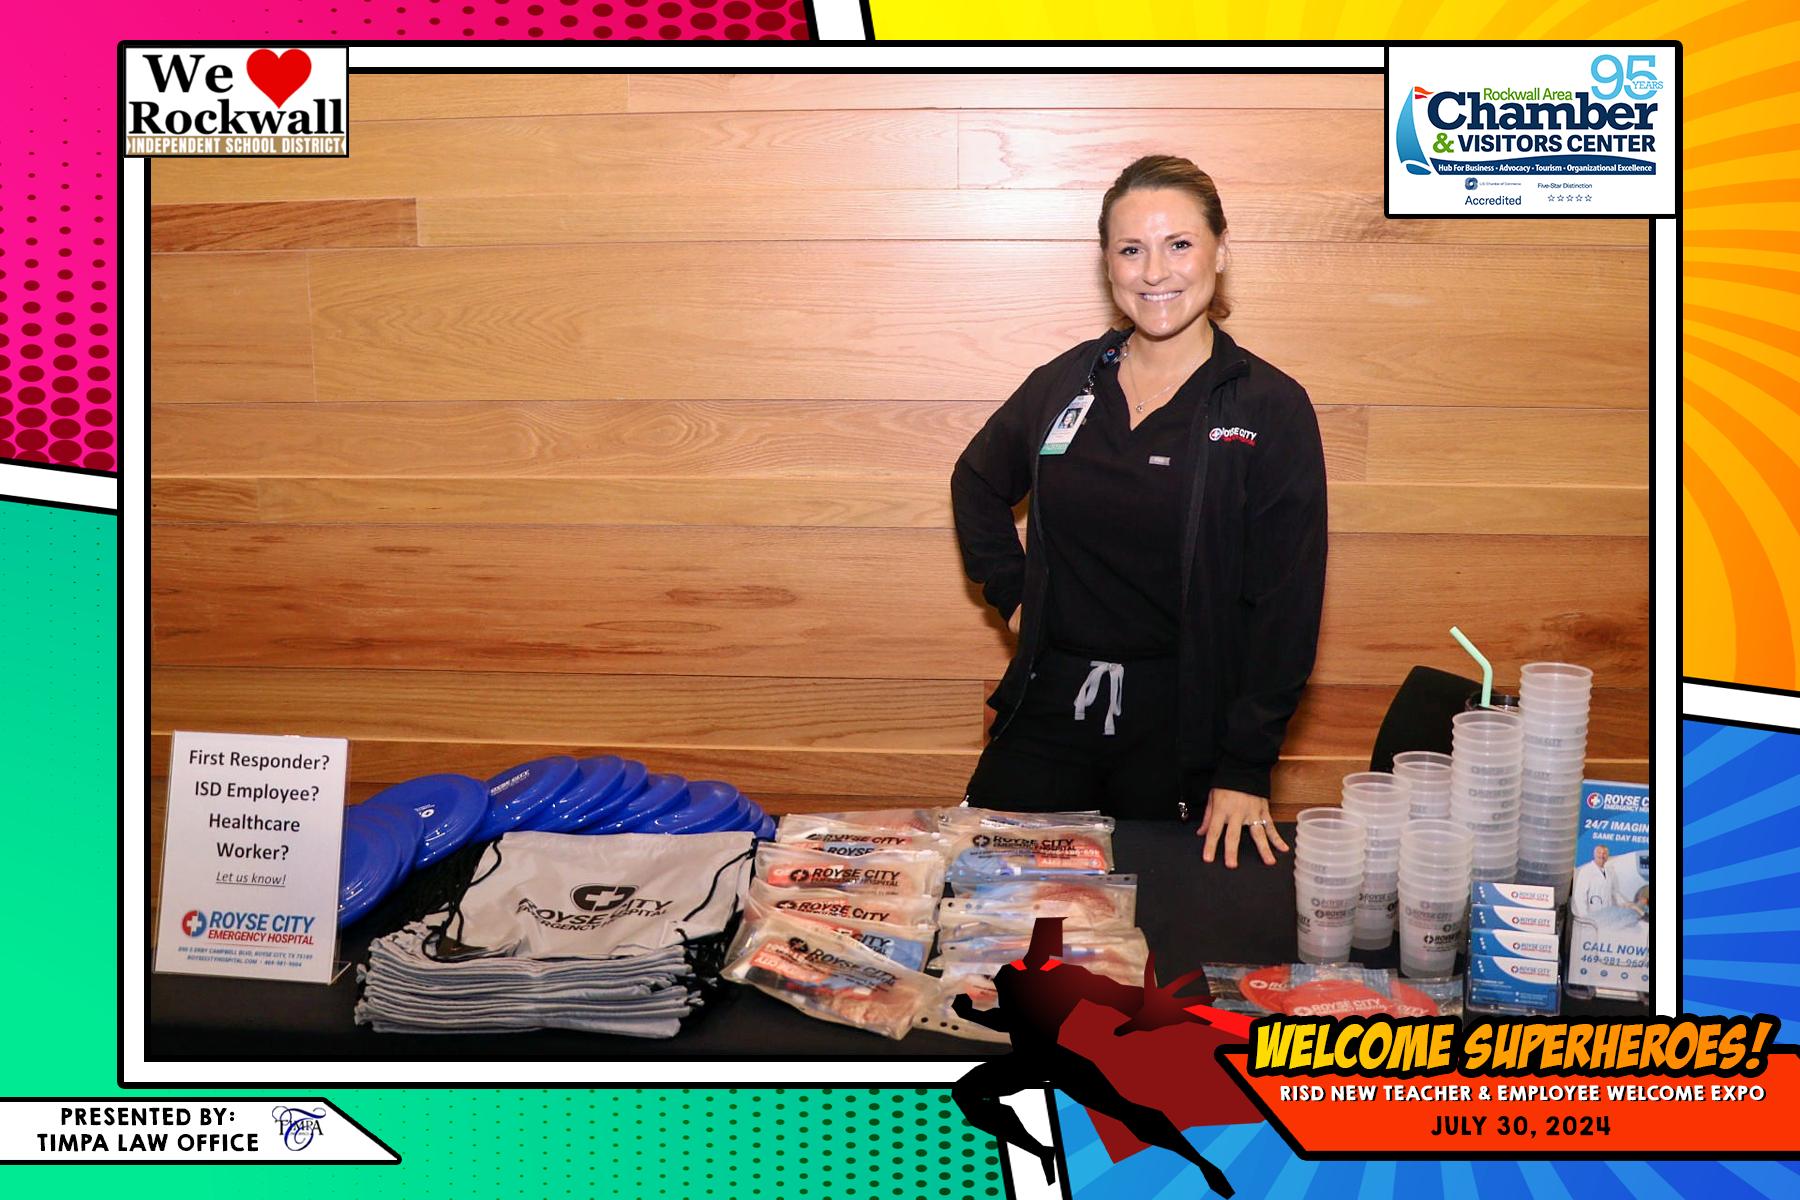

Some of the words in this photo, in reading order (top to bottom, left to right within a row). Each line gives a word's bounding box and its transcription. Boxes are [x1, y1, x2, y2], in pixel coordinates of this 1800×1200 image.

[1240, 428, 1257, 440] CITY
[189, 750, 224, 766] First
[230, 752, 330, 770] Responder?
[195, 781, 222, 796] ISD
[227, 782, 319, 803] Employee?
[1604, 794, 1640, 806] ROYSE
[209, 813, 301, 832] Healthcare
[1584, 819, 1609, 830] 24/7
[872, 836, 905, 845] CITY
[1042, 839, 1074, 847] CITY
[1592, 832, 1614, 840] SAME
[216, 842, 289, 860] Worker?
[216, 872, 234, 882] Let
[236, 874, 249, 883] us
[251, 874, 286, 885] know!
[812, 868, 864, 878] ROYSE
[864, 870, 901, 881] CITY
[800, 903, 850, 913] ROYSE
[852, 908, 889, 922] CITY
[210, 911, 270, 930] ROYSE
[271, 915, 316, 933] CITY
[208, 930, 267, 942] EMERGENCY
[268, 934, 314, 945] HOSPITAL
[1583, 941, 1613, 953] CALL
[810, 949, 861, 968] ROYSE
[1312, 1004, 1353, 1014] ROYSE
[1353, 999, 1381, 1009] CITY
